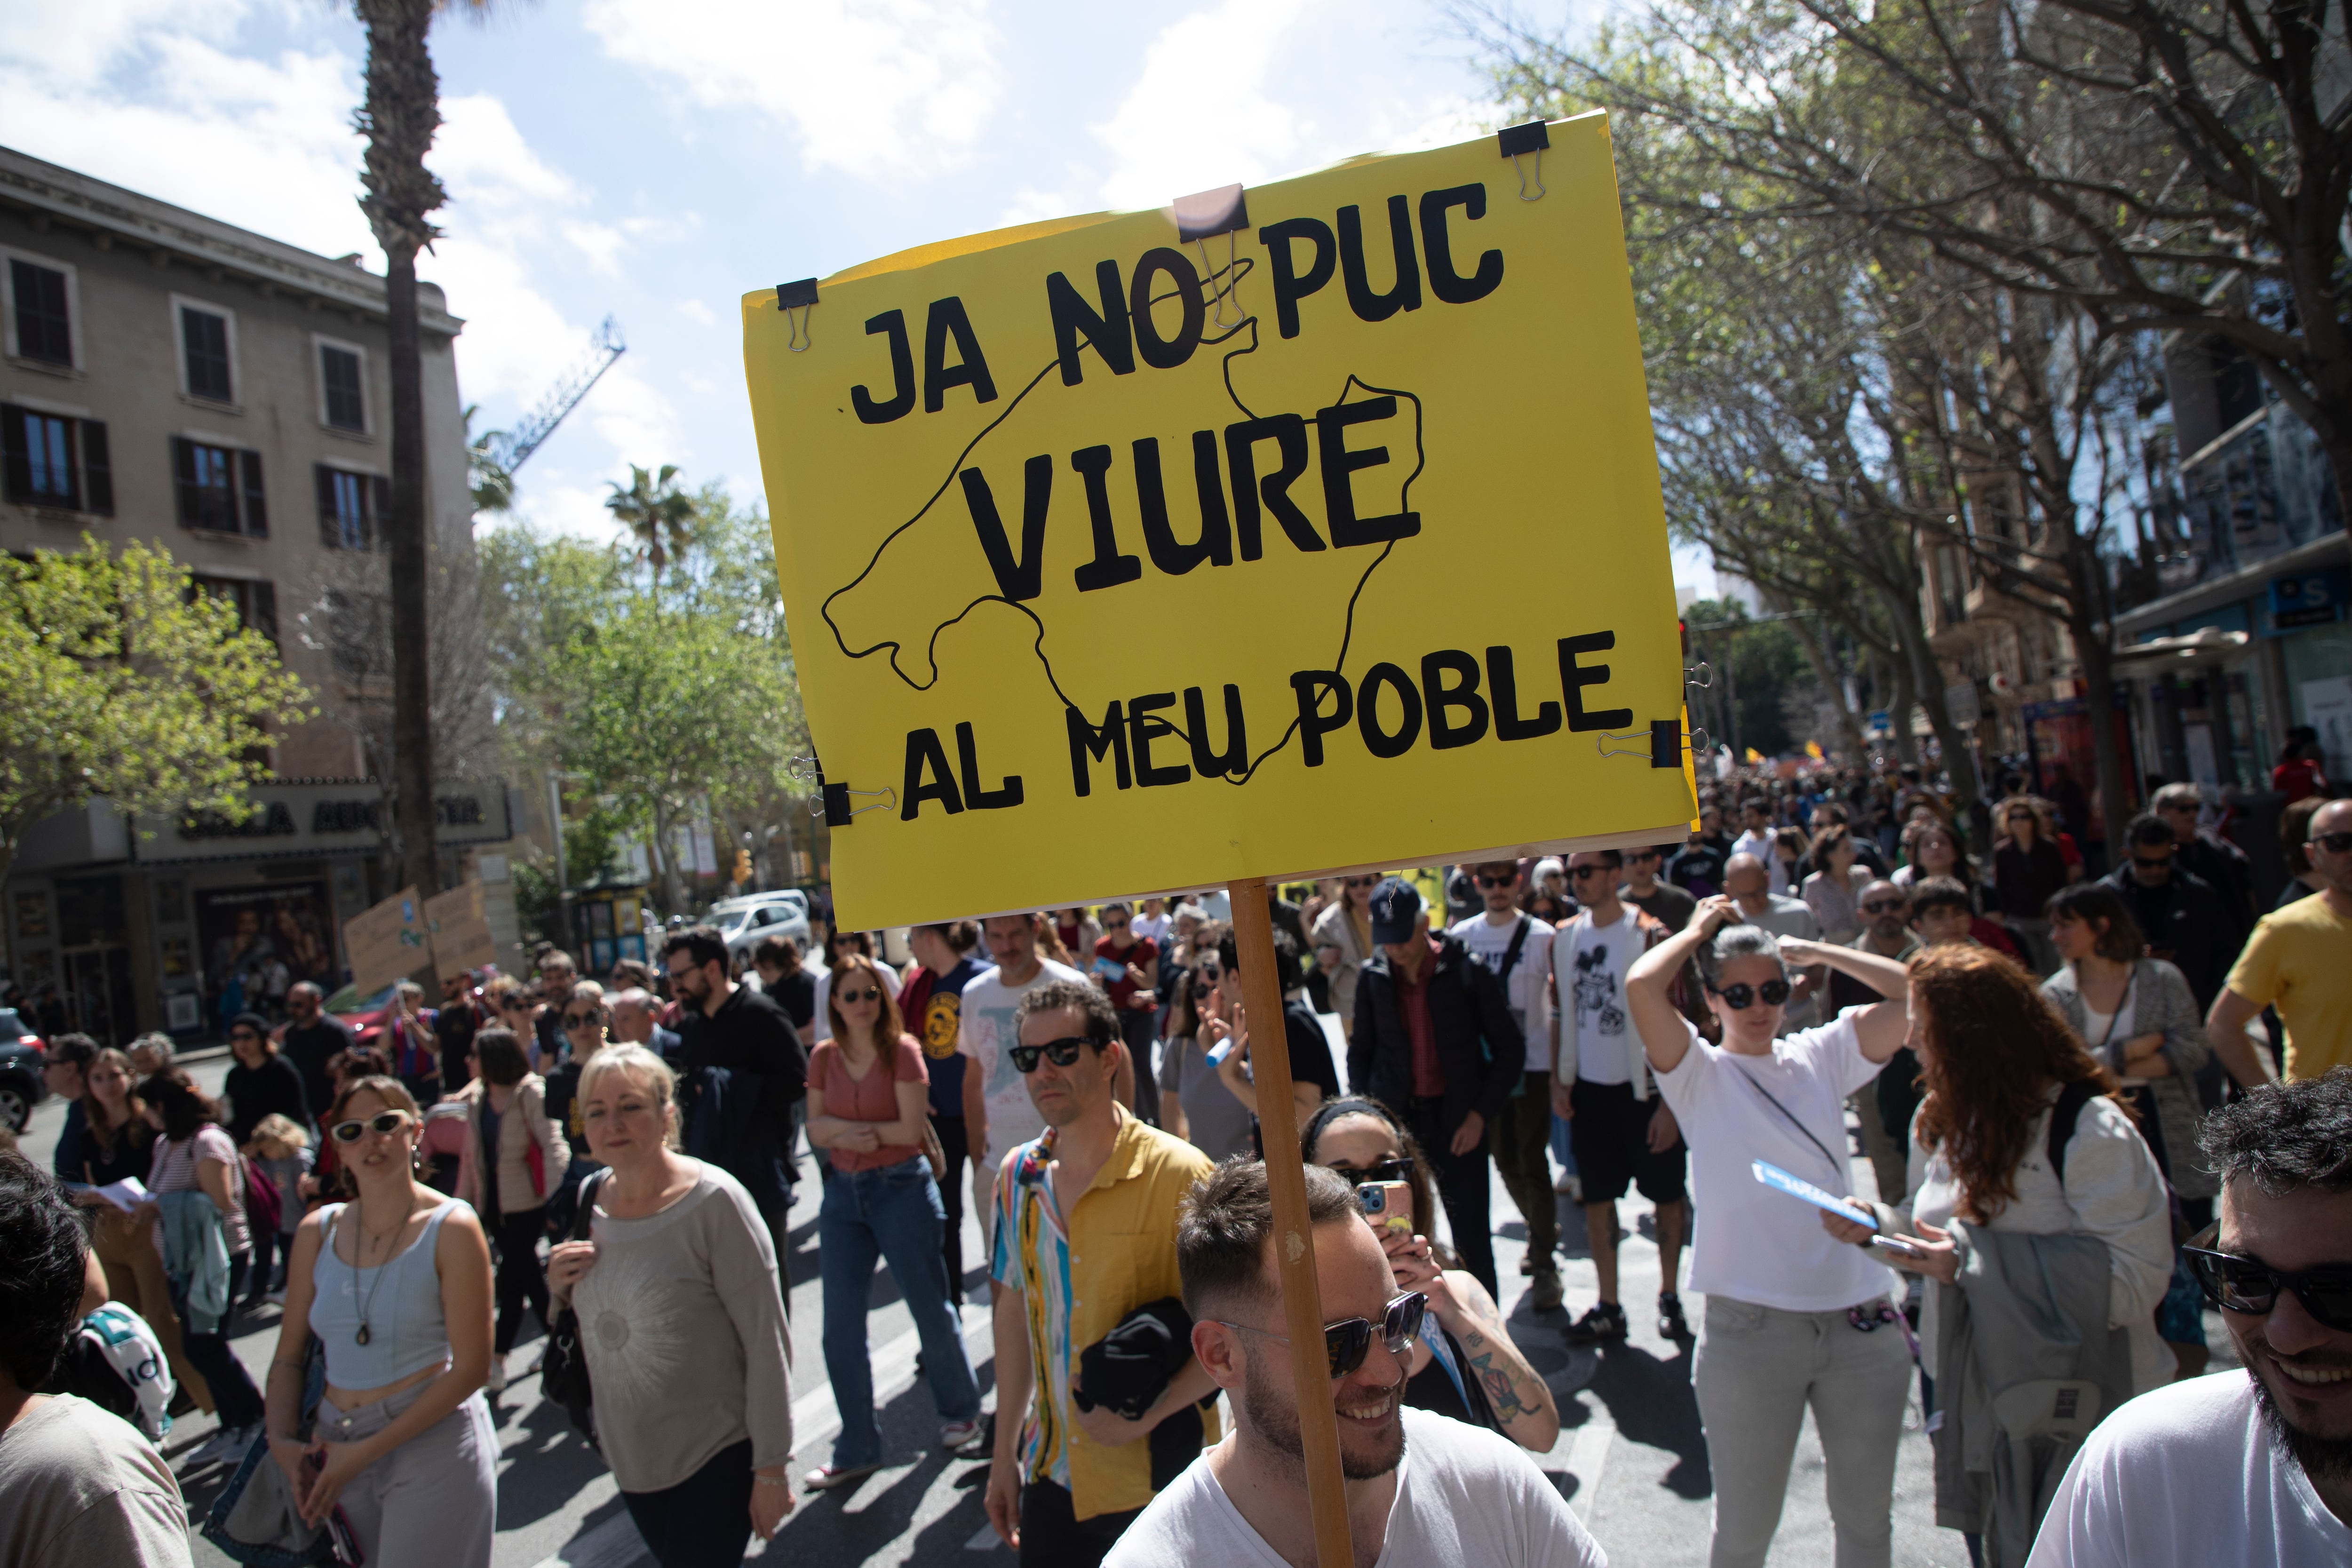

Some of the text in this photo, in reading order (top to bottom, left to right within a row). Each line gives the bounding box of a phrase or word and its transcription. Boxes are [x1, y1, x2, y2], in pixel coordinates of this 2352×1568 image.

[850, 183, 1504, 424] JA NO PUC
[958, 395, 1421, 606] VIURE
[900, 630, 1633, 821] AL MEU POBLE
